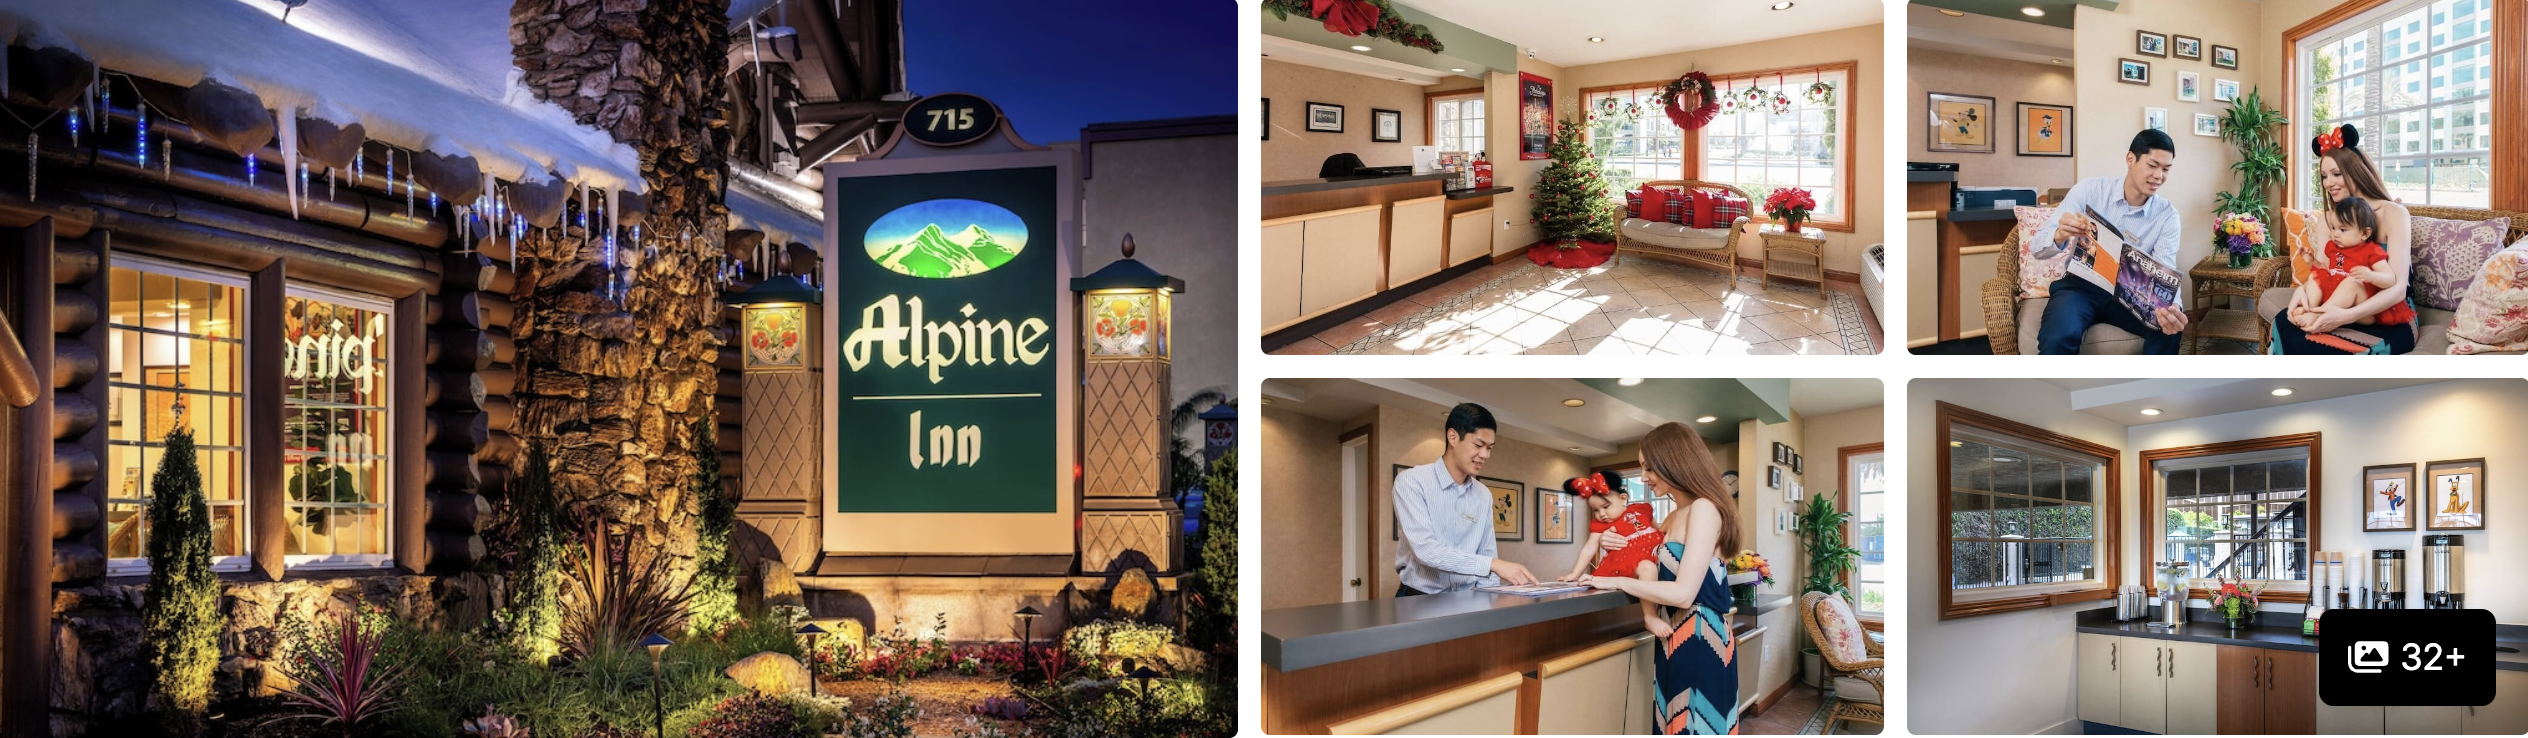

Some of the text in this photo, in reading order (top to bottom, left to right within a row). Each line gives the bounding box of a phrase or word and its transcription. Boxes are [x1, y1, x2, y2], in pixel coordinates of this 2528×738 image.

[926, 106, 975, 132] 715
[2127, 250, 2179, 286] Anaheim
[843, 293, 1050, 385] Alpine
[909, 409, 982, 471] Inn
